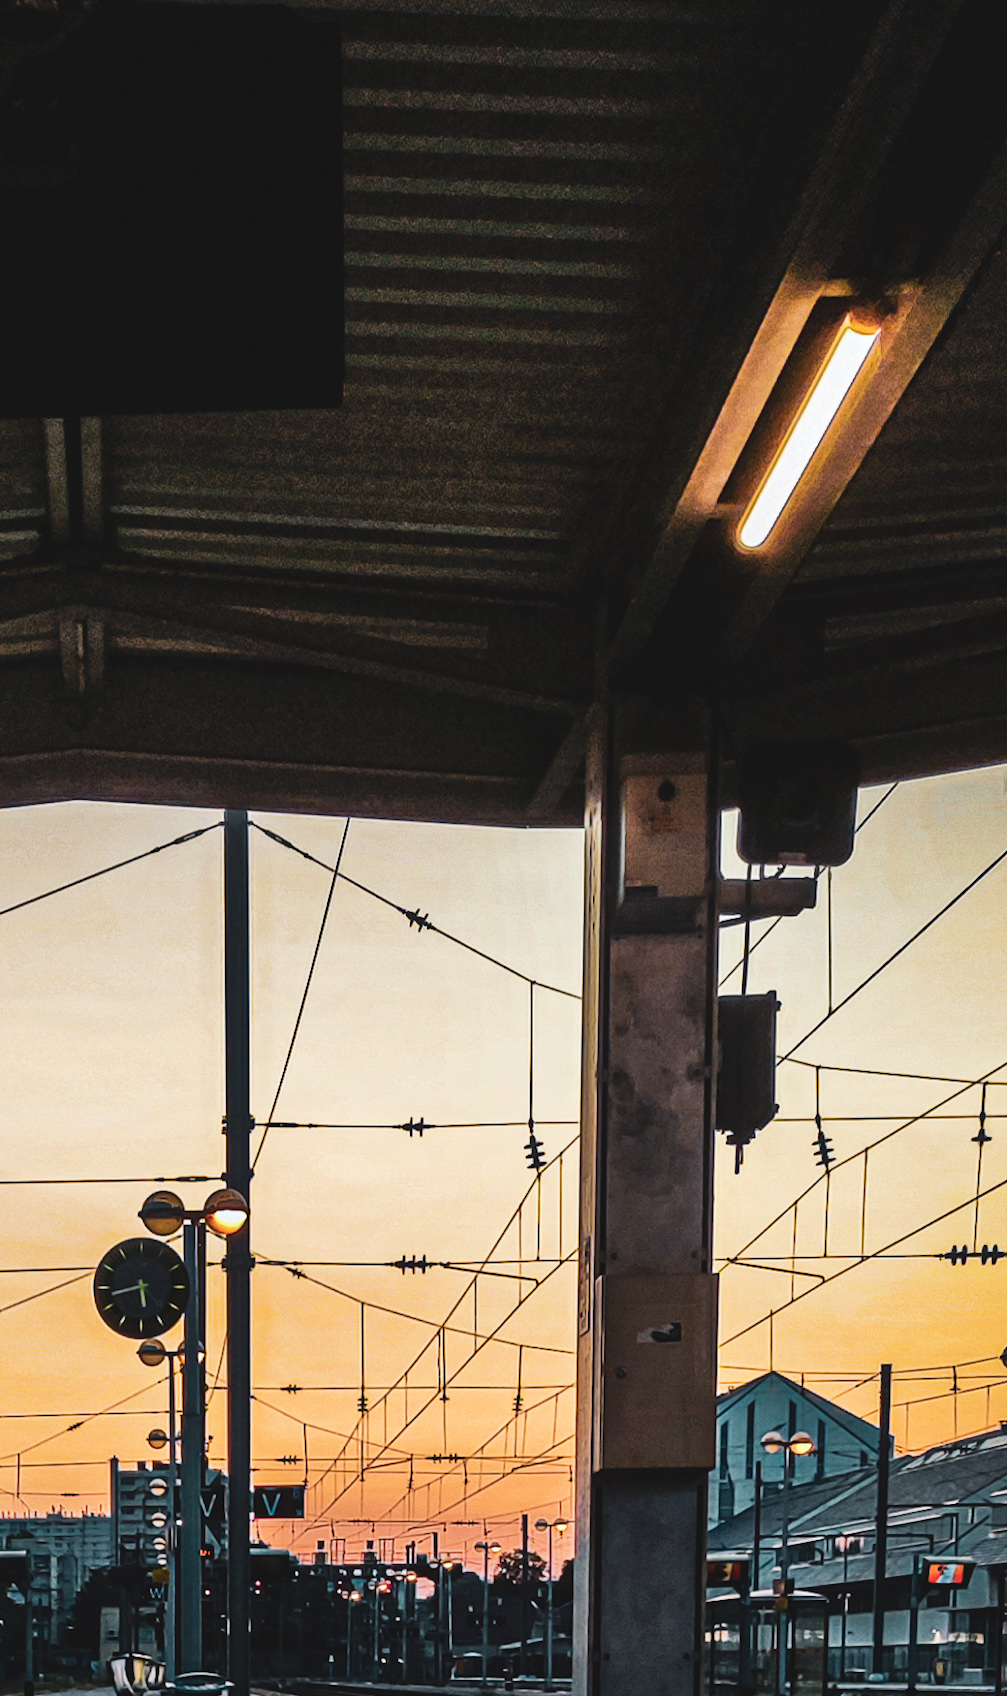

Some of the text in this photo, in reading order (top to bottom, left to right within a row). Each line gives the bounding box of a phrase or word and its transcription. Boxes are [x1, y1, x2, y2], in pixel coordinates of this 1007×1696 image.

[199, 1493, 217, 1518] V
[262, 1493, 281, 1516] V
[149, 1587, 164, 1599] W
